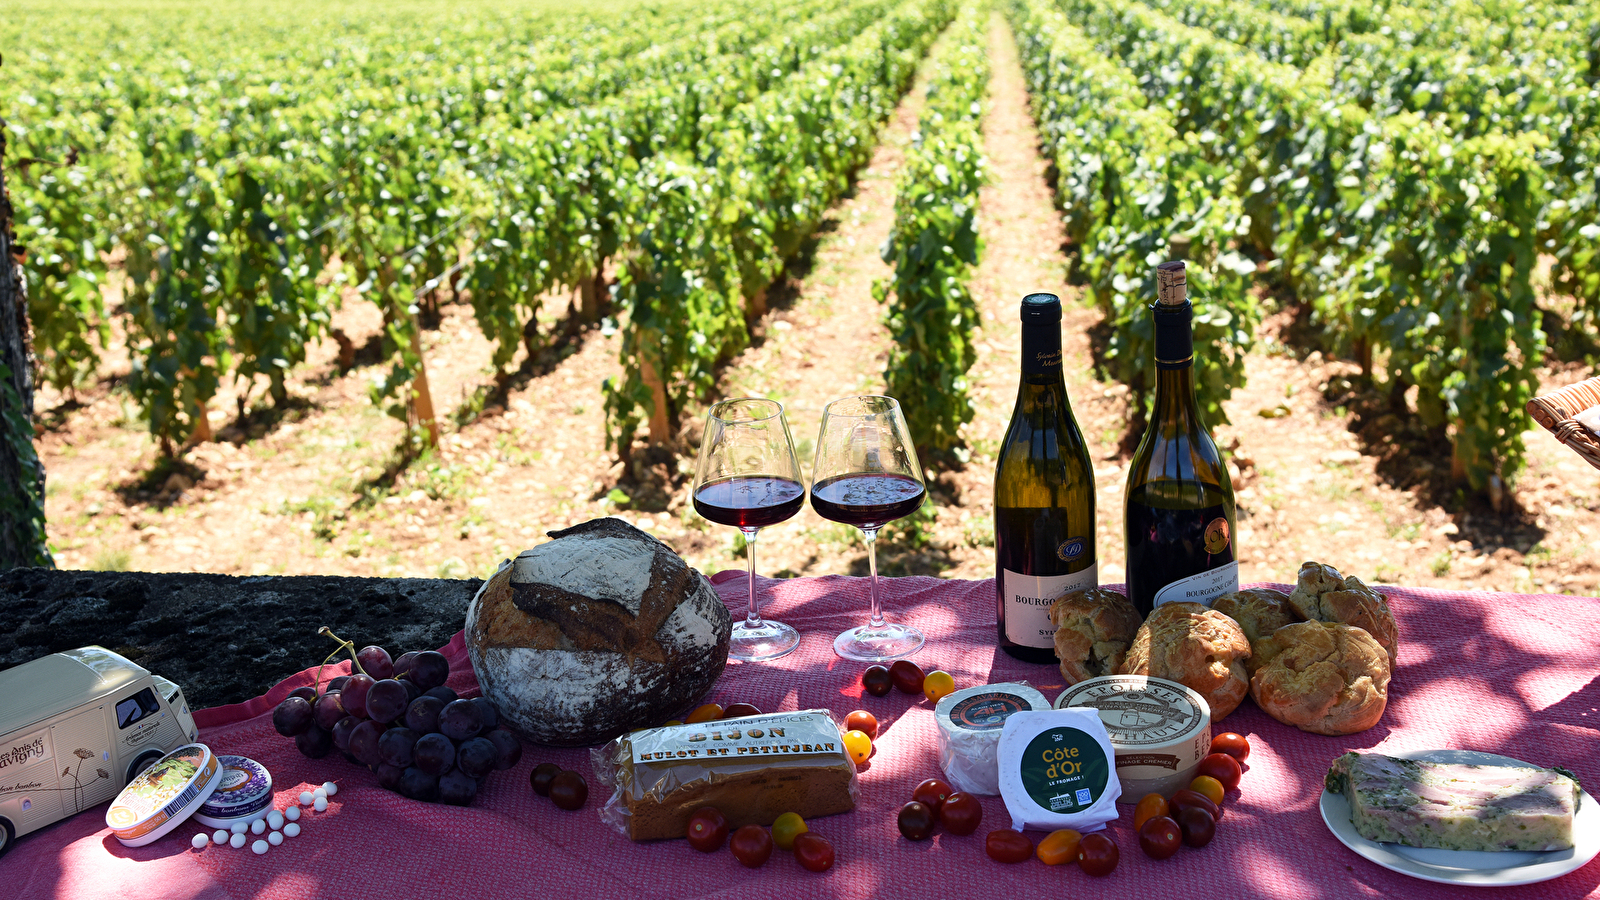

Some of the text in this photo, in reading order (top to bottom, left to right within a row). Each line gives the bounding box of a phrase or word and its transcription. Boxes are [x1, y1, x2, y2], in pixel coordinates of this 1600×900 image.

[1210, 527, 1225, 543] OR
[1064, 582, 1081, 591] 2017
[1212, 575, 1223, 585] 2017
[1186, 583, 1224, 598] BOURGOGNE
[1015, 594, 1056, 607] BOURGO
[1086, 684, 1182, 704] EPOISSES
[688, 727, 785, 742] DIJON
[0, 751, 10, 760] es
[11, 744, 31, 756] Anis
[641, 743, 835, 760] MULOT ET PETITJEAN
[1042, 747, 1079, 763] Côte
[1046, 761, 1082, 779] d'Or
[1056, 776, 1080, 784] FROMAGE
